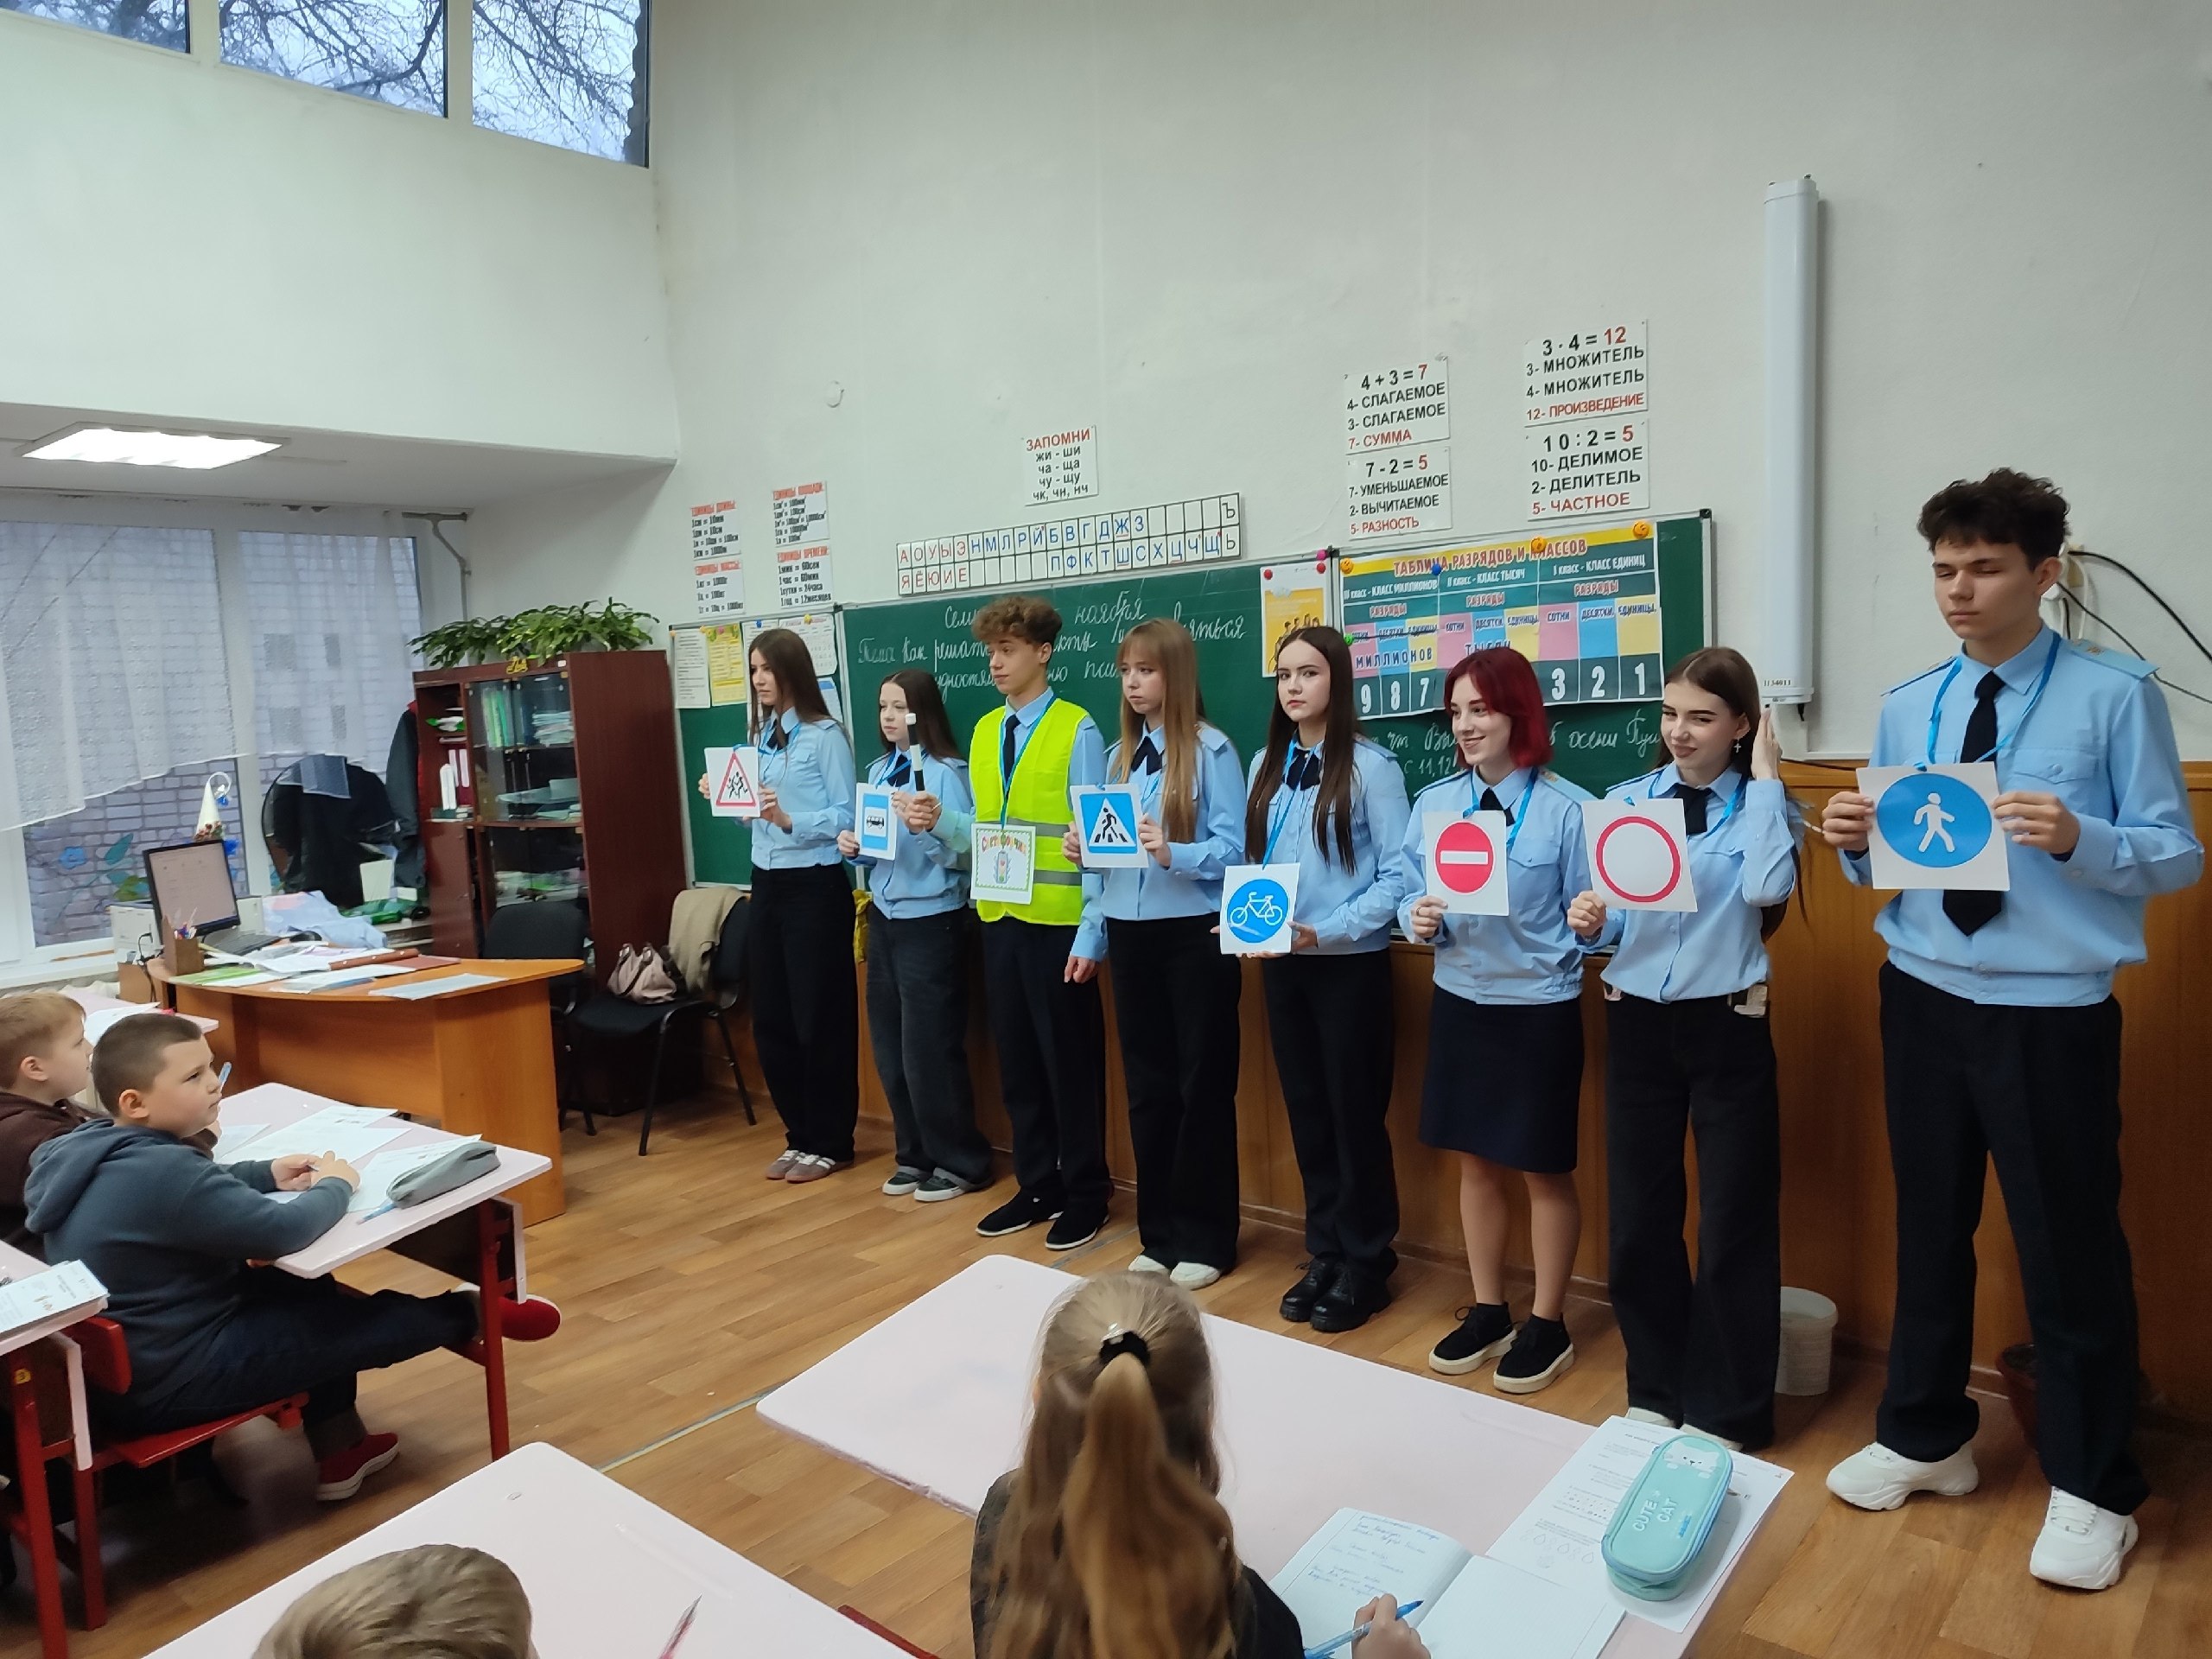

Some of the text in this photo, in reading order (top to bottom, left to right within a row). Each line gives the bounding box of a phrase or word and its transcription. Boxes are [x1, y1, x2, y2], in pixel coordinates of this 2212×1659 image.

[1542, 339, 1552, 357] 3
[1569, 334, 1580, 351] 4
[1604, 326, 1627, 346] 12
[1543, 345, 1644, 374] МНОЖИТЕЛЬ
[1361, 374, 1370, 391] 4
[1389, 370, 1399, 385] 3
[1418, 363, 1427, 380] 7
[1544, 368, 1644, 397] МНОЖИТЕЛЬ
[1361, 381, 1446, 409] СЛАГАЕМОЕ
[1549, 392, 1644, 418] ПРОИЗВЕДЕНИЕ
[1363, 402, 1446, 428] СЛАГАЕМОЕ
[1026, 428, 1090, 452] ЗАПОМНИ
[1363, 429, 1412, 448] СУММА
[1586, 429, 1599, 448] 2
[1622, 424, 1634, 442] 5
[1036, 446, 1081, 462] жи ши
[1365, 461, 1375, 478] 7
[1389, 458, 1399, 474] 2
[1418, 454, 1428, 470] 5
[1558, 446, 1643, 473] ДЕЛИМОЕ
[1039, 459, 1080, 474] ча ща
[1039, 472, 1081, 489] чу щу
[1074, 484, 1089, 495] нч
[1360, 474, 1449, 497] УМЕНЬШАЕМОЕ
[1548, 469, 1641, 495] ДЕЛИТЕЛЬ
[1361, 493, 1440, 515] ВЫЧИТАЕМОЕ
[1550, 492, 1630, 512] ЧАСТНОЕ
[899, 502, 1236, 564] А О У Ы Э Н М Л Р Й Б В Г Д Ж З Ъ
[1362, 516, 1420, 534] РАЗНОСТЬ
[901, 533, 1236, 589] Я Ё Ю И Е П Ф К Т Ш С Х Ц Ч Щ Ь
[1452, 547, 1514, 571] РАЗРЯДОВ
[1517, 544, 1525, 561] И
[1586, 557, 1611, 572] КЛАСС
[1612, 554, 1646, 569] ЕДИНИЦ
[1371, 583, 1394, 597] КЛАСС
[1394, 579, 1439, 594] МИЛЛИОНОВ
[1477, 571, 1500, 584] КЛАСС
[1500, 569, 1525, 581] ТЫСЯЧ
[1573, 580, 1619, 597] РАЗРЯДЫ
[1370, 603, 1407, 619] РАЗРЯДЫ
[1466, 591, 1505, 607] РАЗРЯДЫ
[1074, 590, 1147, 644] ноября
[1547, 611, 1570, 621] СОТНИ
[1356, 646, 1433, 669] МИЛЛИОНОВ
[1360, 662, 1645, 714] 9 8 7 3 2 1
[1632, 1499, 1658, 1532] CUTE
[1656, 1497, 1678, 1523] CAT
